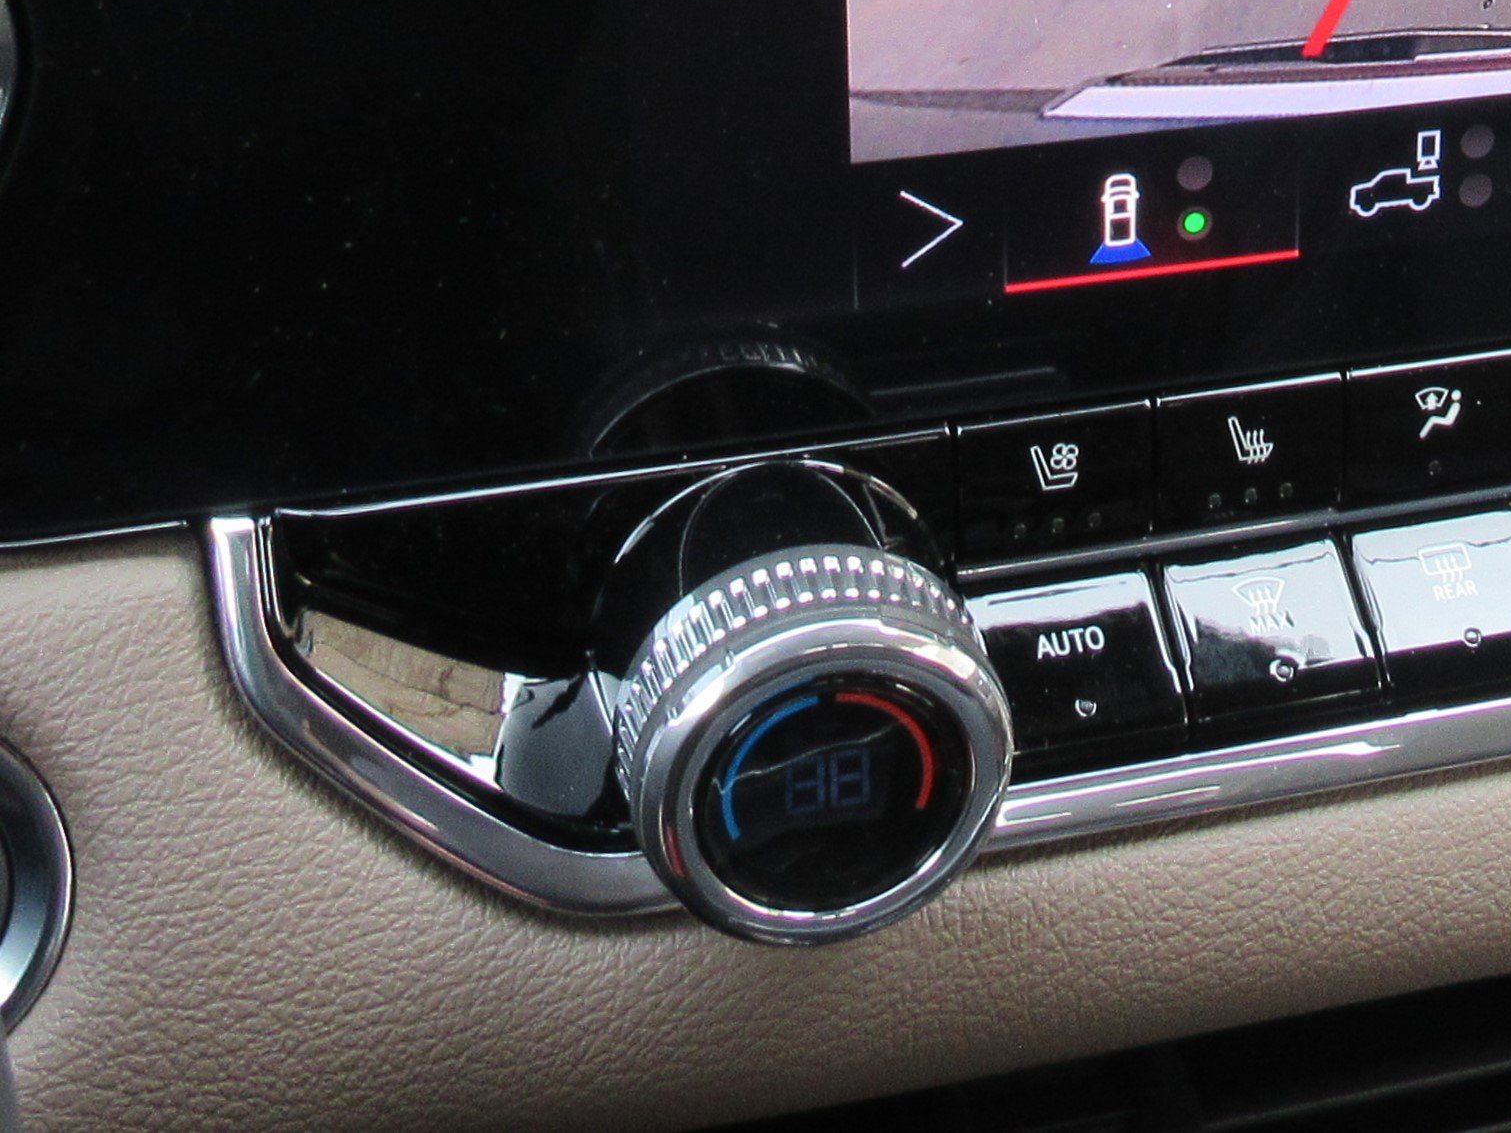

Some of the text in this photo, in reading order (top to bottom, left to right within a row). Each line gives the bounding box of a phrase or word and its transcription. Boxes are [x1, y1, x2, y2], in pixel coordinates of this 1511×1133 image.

[1432, 579, 1479, 602] REAR
[1250, 610, 1293, 634] MAX
[1037, 625, 1105, 660] AUTO
